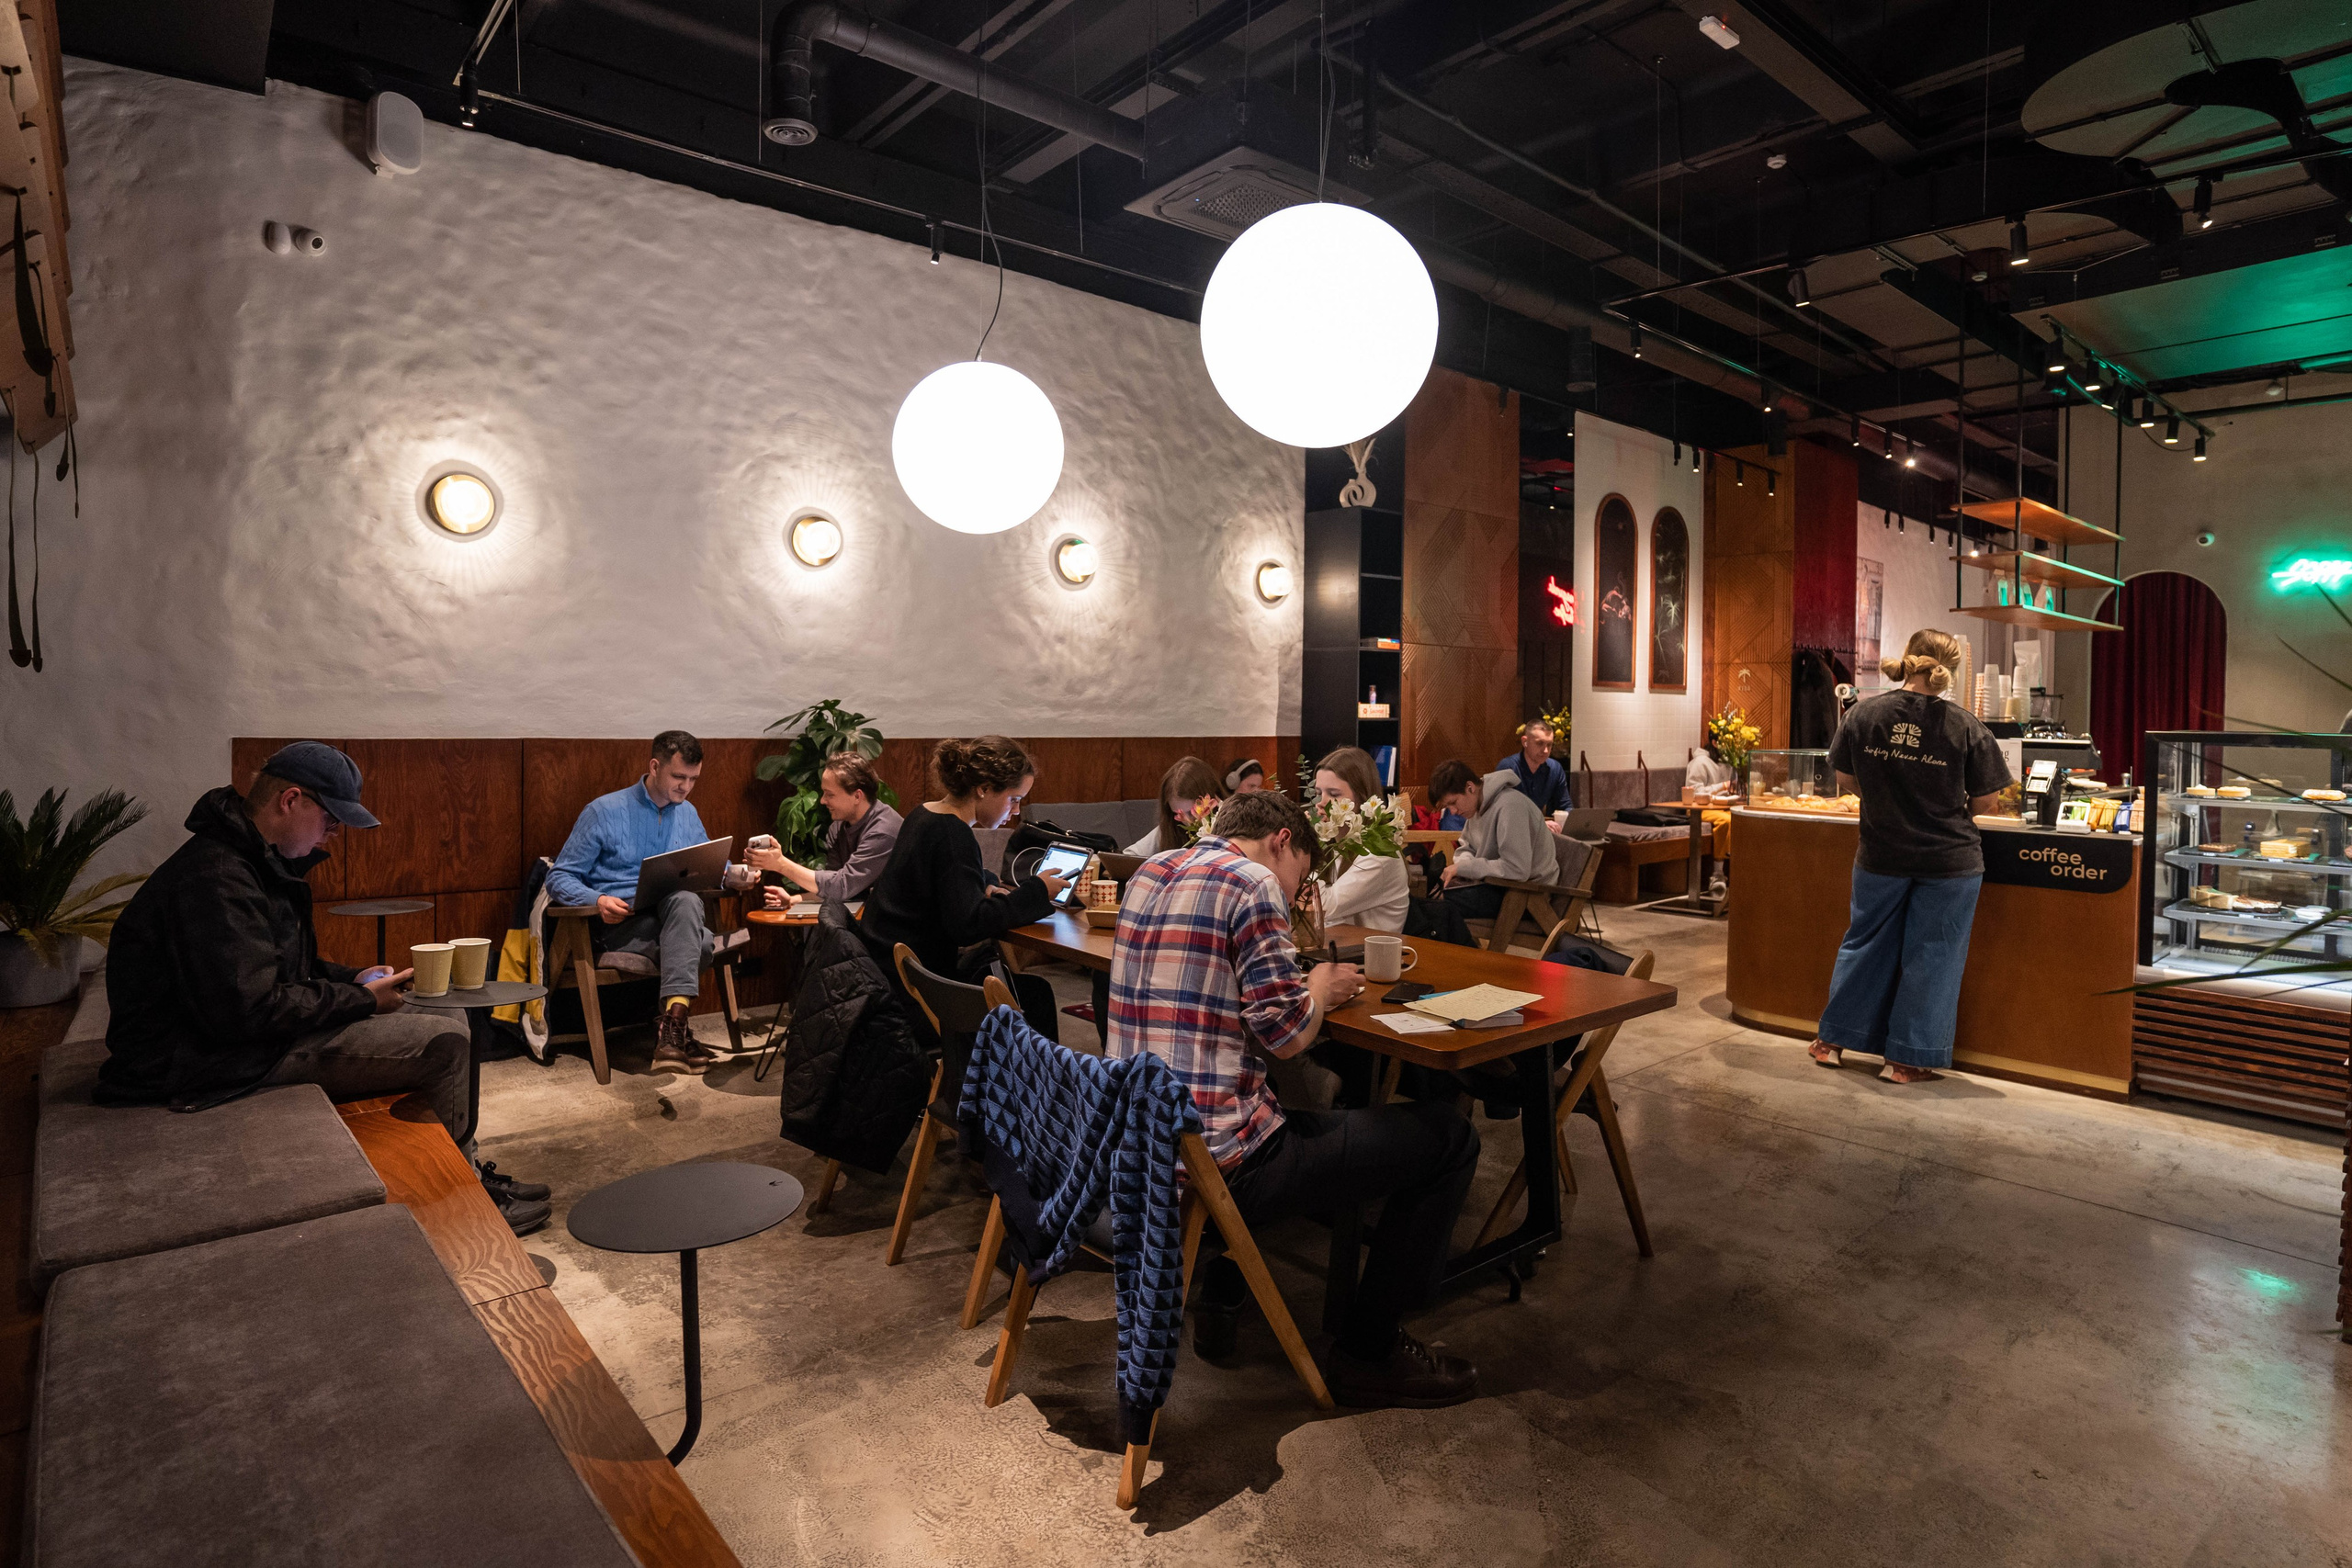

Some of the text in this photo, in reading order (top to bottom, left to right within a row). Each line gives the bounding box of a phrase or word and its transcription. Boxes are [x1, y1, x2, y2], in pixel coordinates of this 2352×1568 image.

[1891, 749, 1918, 761] Never
[1921, 754, 1948, 766] Alone
[2018, 847, 2082, 864] coffee
[2050, 864, 2107, 880] order
